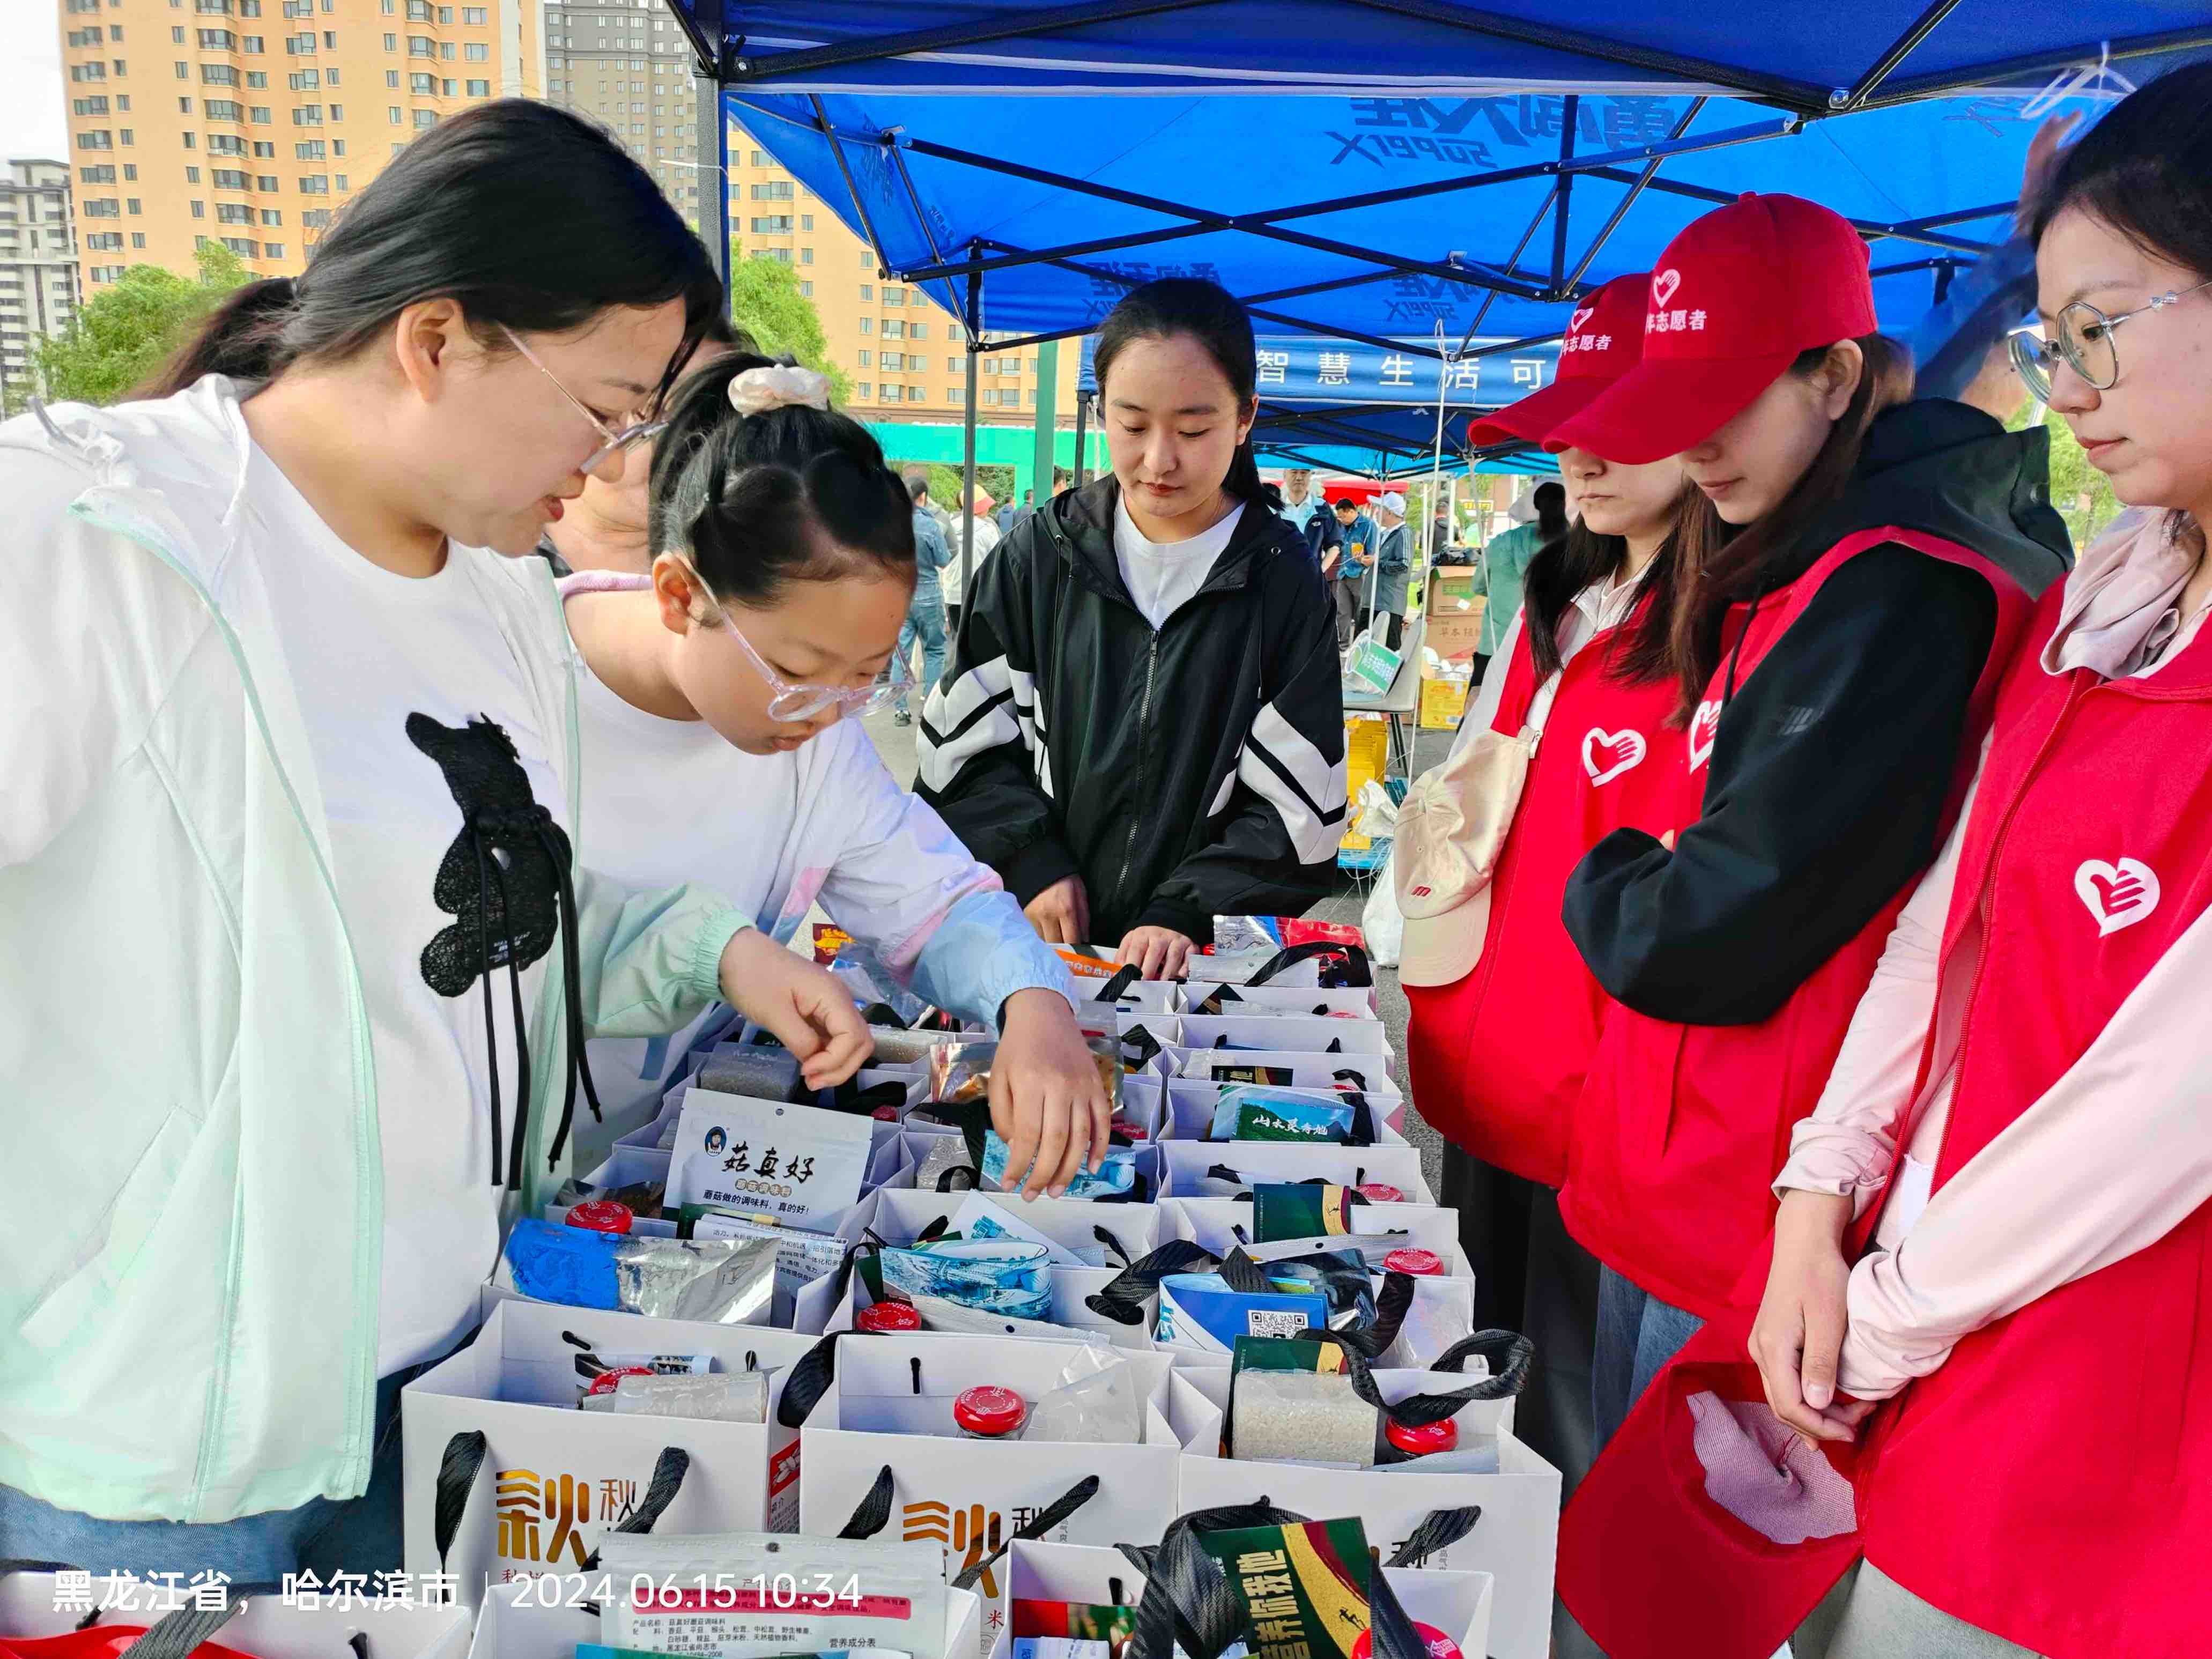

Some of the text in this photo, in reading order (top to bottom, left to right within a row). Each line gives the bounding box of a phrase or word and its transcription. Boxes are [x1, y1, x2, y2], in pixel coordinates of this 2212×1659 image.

[721, 1140, 815, 1184] 菇真好
[829, 1638, 876, 1648] 营养成分表
